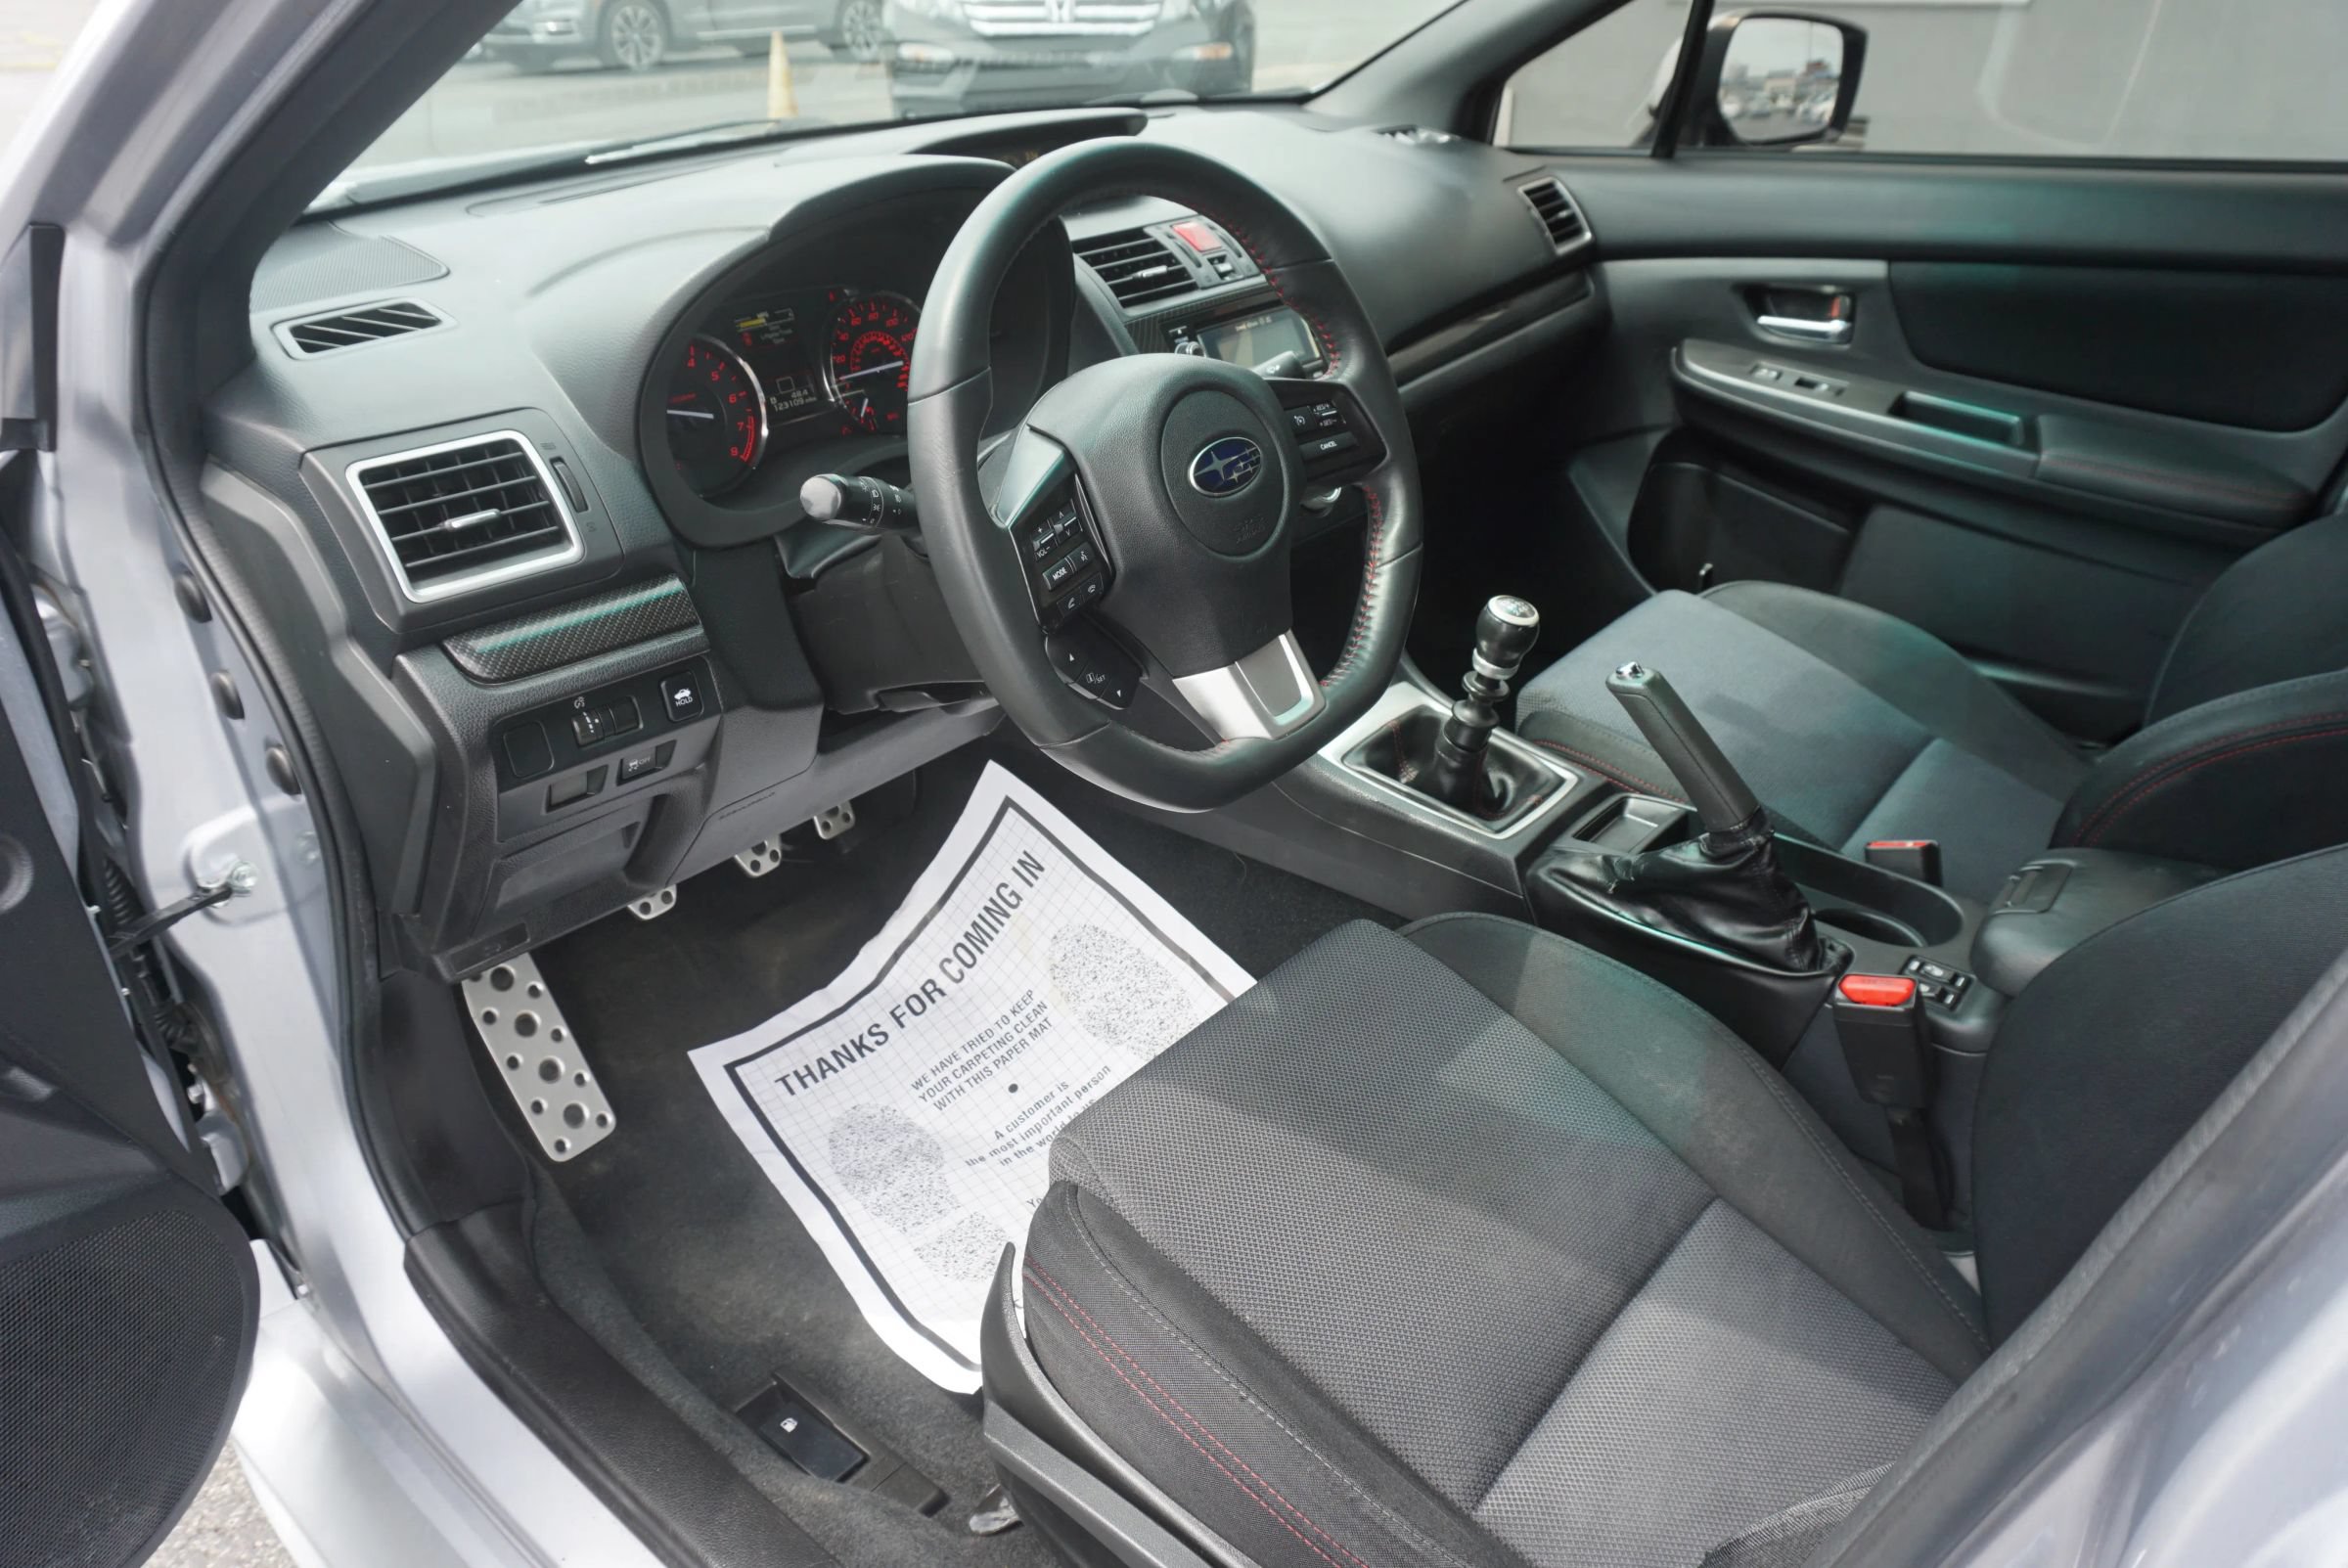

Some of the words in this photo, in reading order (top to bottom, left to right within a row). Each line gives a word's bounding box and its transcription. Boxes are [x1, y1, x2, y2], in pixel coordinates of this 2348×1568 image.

[711, 371, 720, 381] 5
[728, 393, 737, 403] 6
[773, 397, 804, 412] 123109
[737, 422, 745, 431] 7
[1320, 440, 1337, 451] CANCEL
[1053, 566, 1067, 581] MODE
[675, 696, 693, 706] HOLD
[774, 1023, 889, 1097] THANKS
[888, 978, 947, 1029] FOR
[938, 881, 1023, 984] COMING
[1011, 850, 1045, 888] IN
[911, 1073, 931, 1091] WE
[930, 1051, 962, 1077] HAVE
[961, 1028, 995, 1054] TRIED
[994, 1014, 1011, 1030] TO
[1009, 989, 1034, 1017] KEEP
[919, 1076, 952, 1103] YOUR
[952, 1031, 1015, 1080] CARPETING
[1014, 1001, 1049, 1034] CLEAN
[933, 1085, 967, 1111] WITH
[964, 1066, 993, 1089] THIS
[992, 1038, 1030, 1070] PAPER
[1028, 1017, 1053, 1042] MAT
[965, 1154, 987, 1167] the
[988, 1138, 1019, 1158] most
[1020, 1096, 1074, 1142] important
[1073, 1064, 1111, 1099] person
[994, 1130, 1005, 1141] A
[1005, 1091, 1056, 1134] customer
[1058, 1081, 1070, 1093] is
[1000, 1156, 1013, 1167] in
[1014, 1144, 1035, 1160] the
